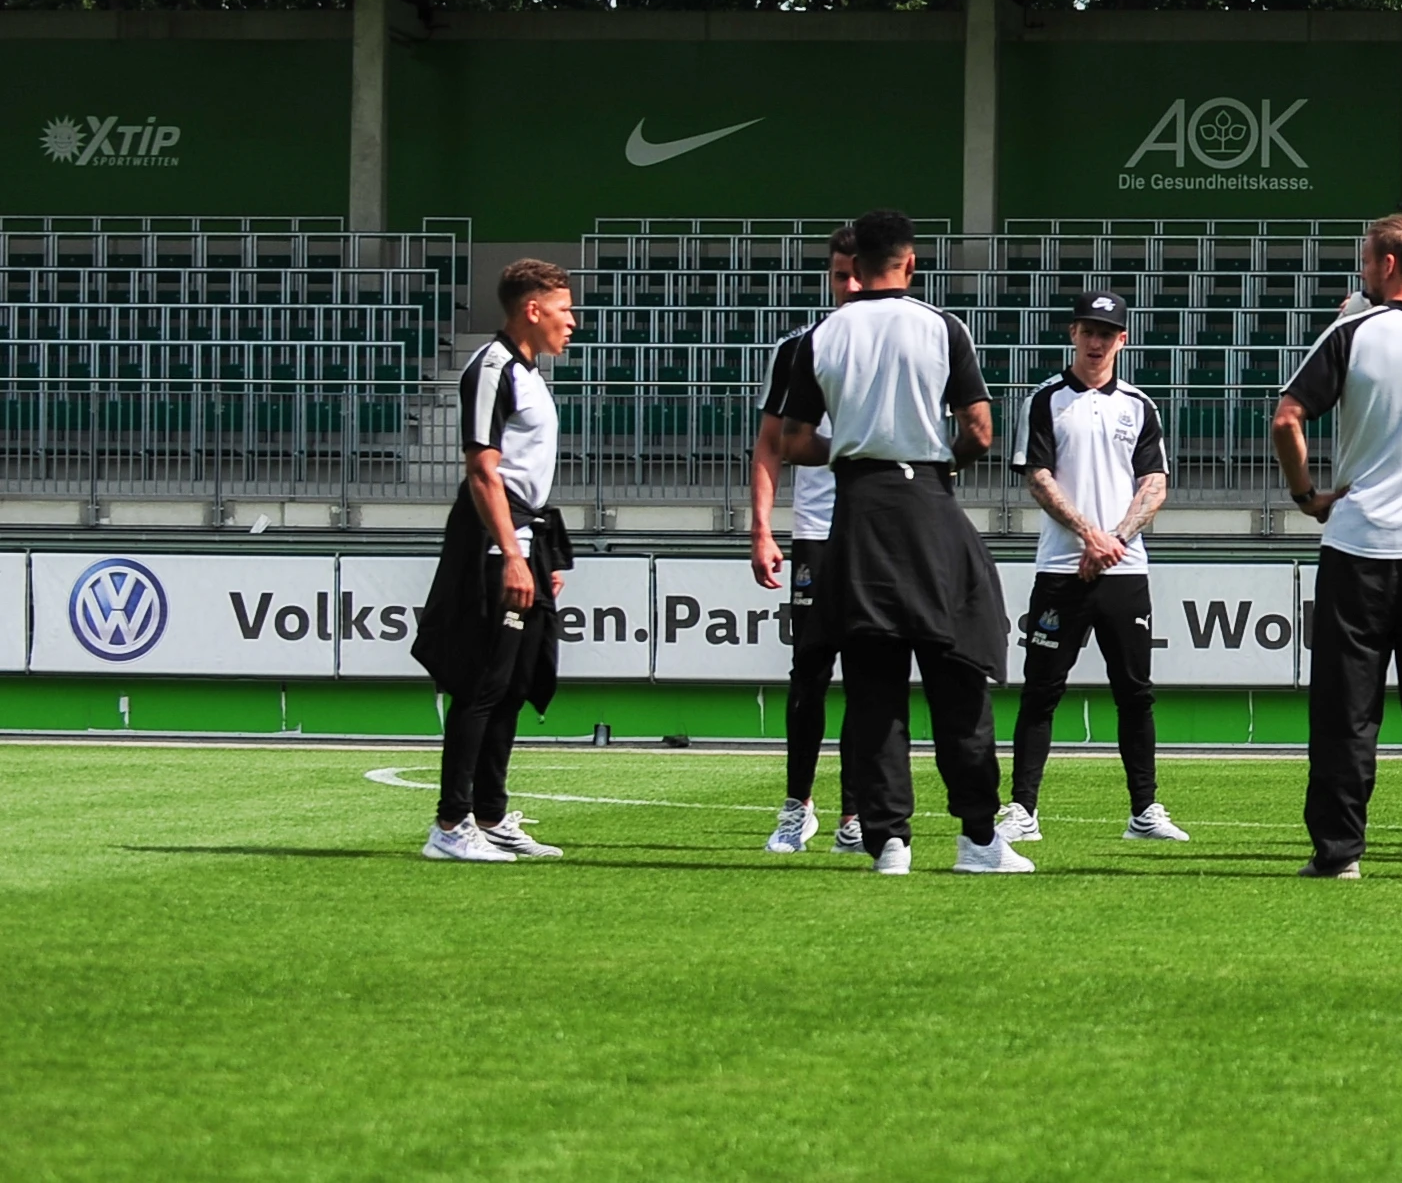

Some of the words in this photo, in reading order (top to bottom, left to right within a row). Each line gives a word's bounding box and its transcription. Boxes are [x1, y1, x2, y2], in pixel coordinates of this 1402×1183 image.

[1123, 97, 1310, 170] AOK
[91, 156, 180, 167] SPORTWETTEN
[1118, 174, 1146, 190] Die
[1150, 174, 1315, 190] Gesundheitskasse.
[228, 591, 648, 644] Volksen.
[664, 594, 795, 646] Part
